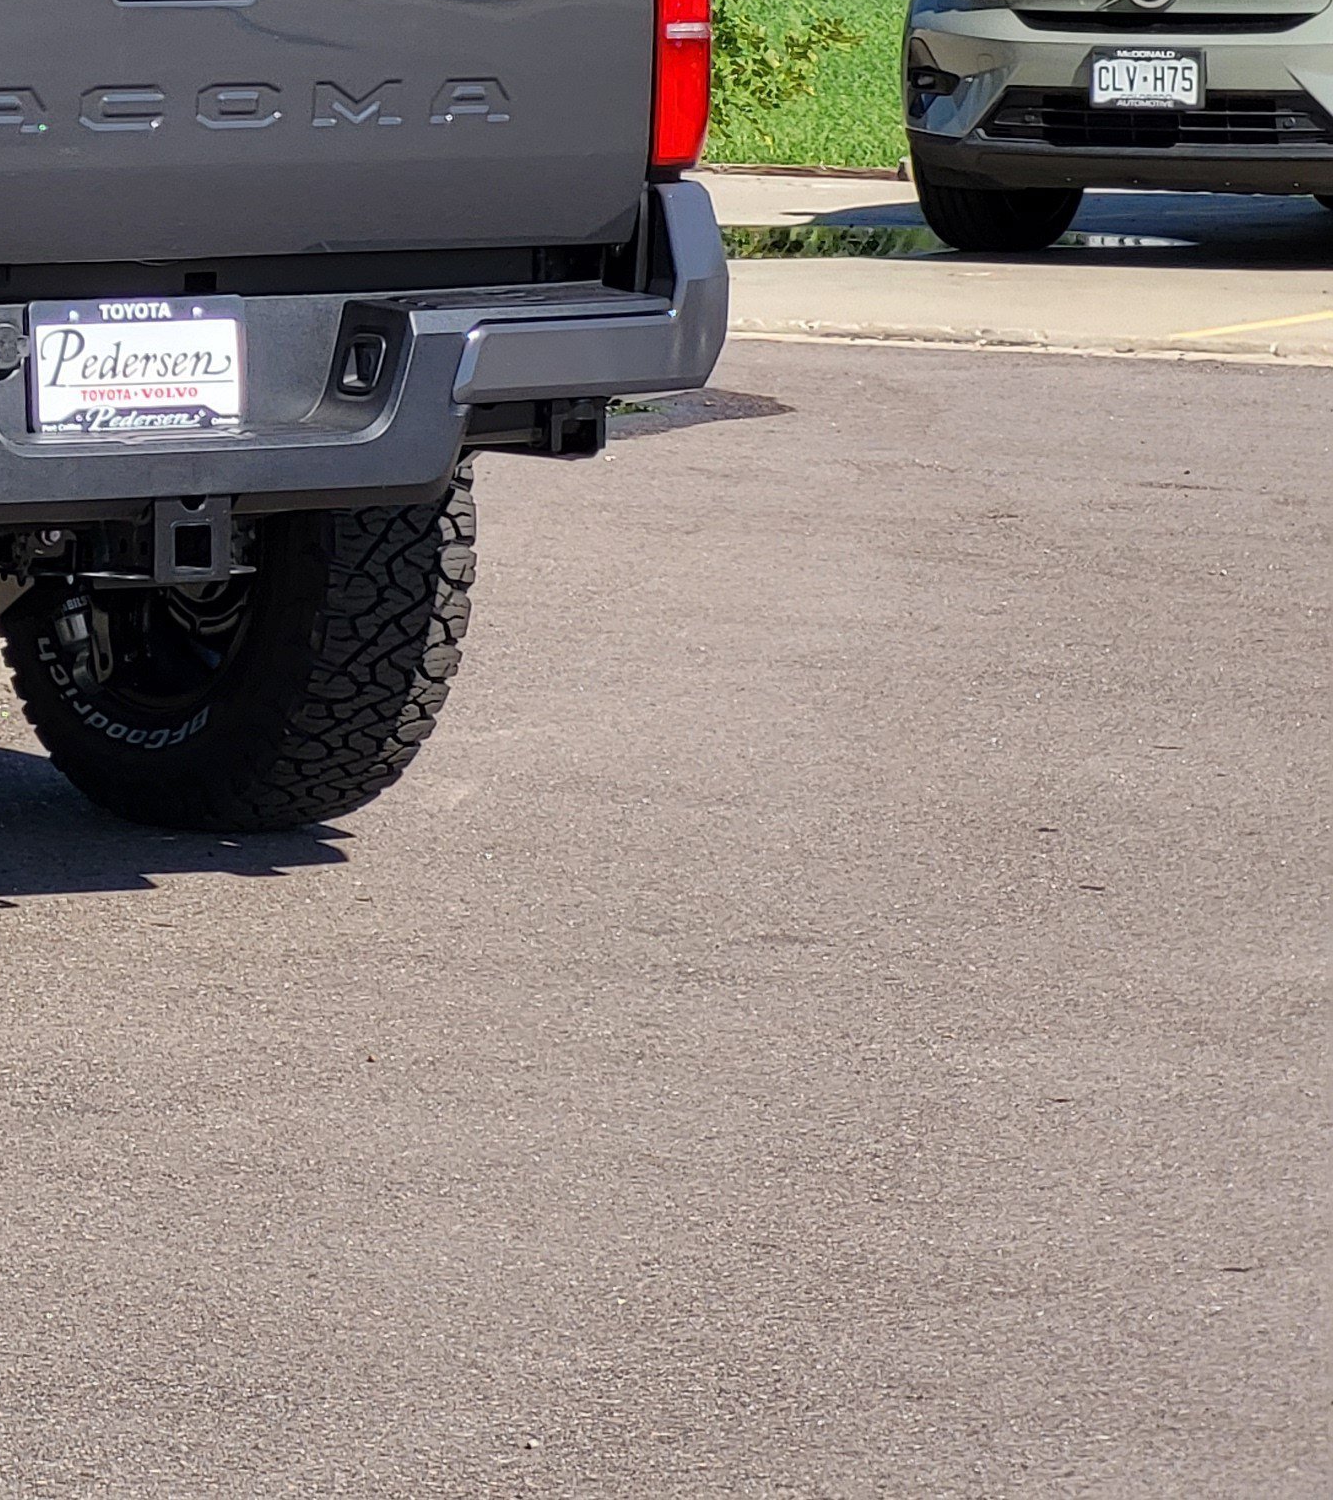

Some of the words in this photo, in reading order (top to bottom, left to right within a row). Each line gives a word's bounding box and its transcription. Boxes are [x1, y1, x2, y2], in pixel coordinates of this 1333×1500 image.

[1116, 50, 1176, 59] McDONALD
[1116, 100, 1175, 108] AUTOMOTIVE
[99, 302, 172, 321] TOYOTA
[40, 328, 233, 388] Pedersen
[81, 389, 132, 402] TOYOTA
[141, 386, 199, 399] VOLVO
[85, 405, 201, 432] Pedersen
[37, 636, 210, 750] BFGoodrich
